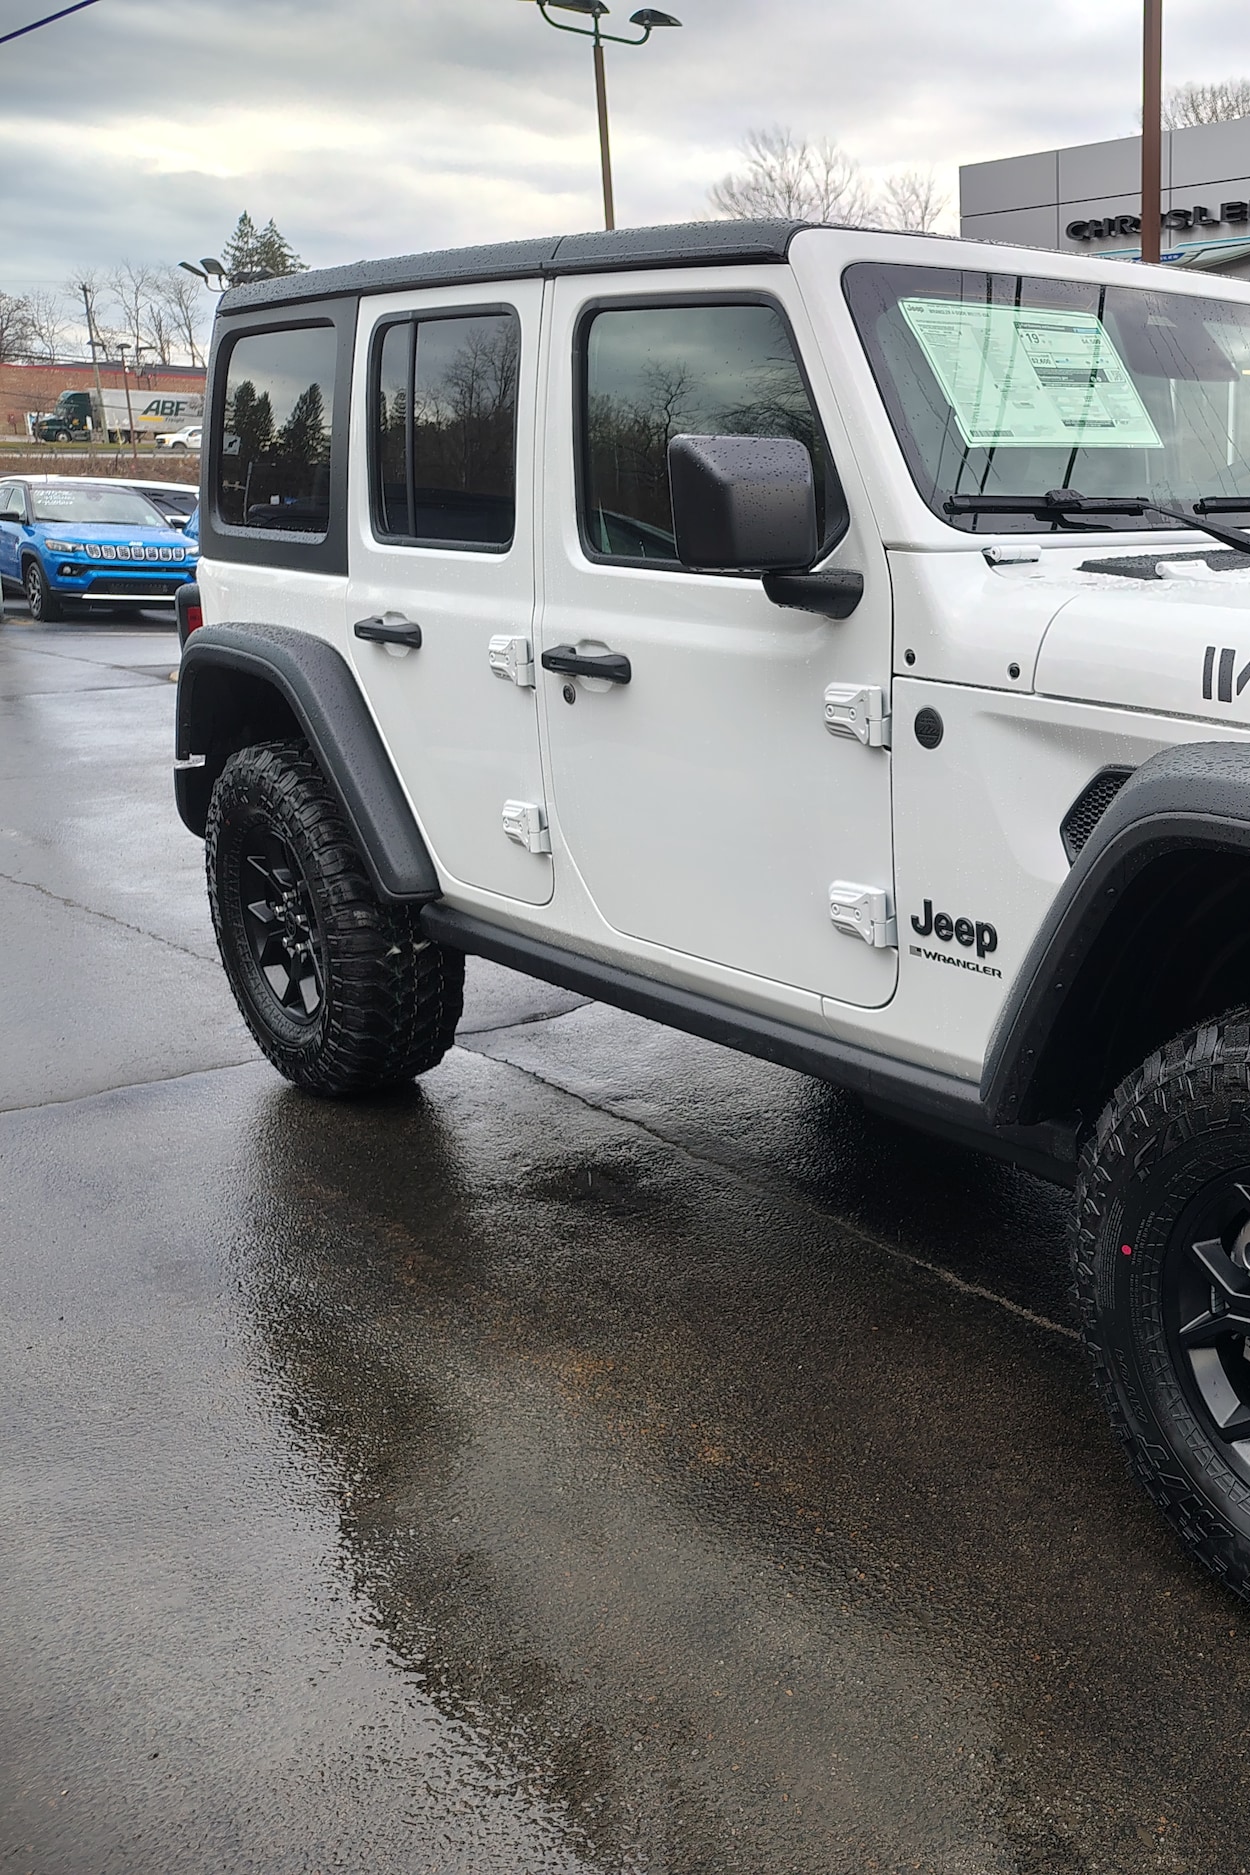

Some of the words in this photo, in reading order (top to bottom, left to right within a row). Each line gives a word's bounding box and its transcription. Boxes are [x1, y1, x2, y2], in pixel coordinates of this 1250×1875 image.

[1026, 333, 1039, 344] 19
[141, 399, 187, 416] ABF
[910, 898, 998, 959] Jeep
[922, 948, 1003, 979] WRANGLER
